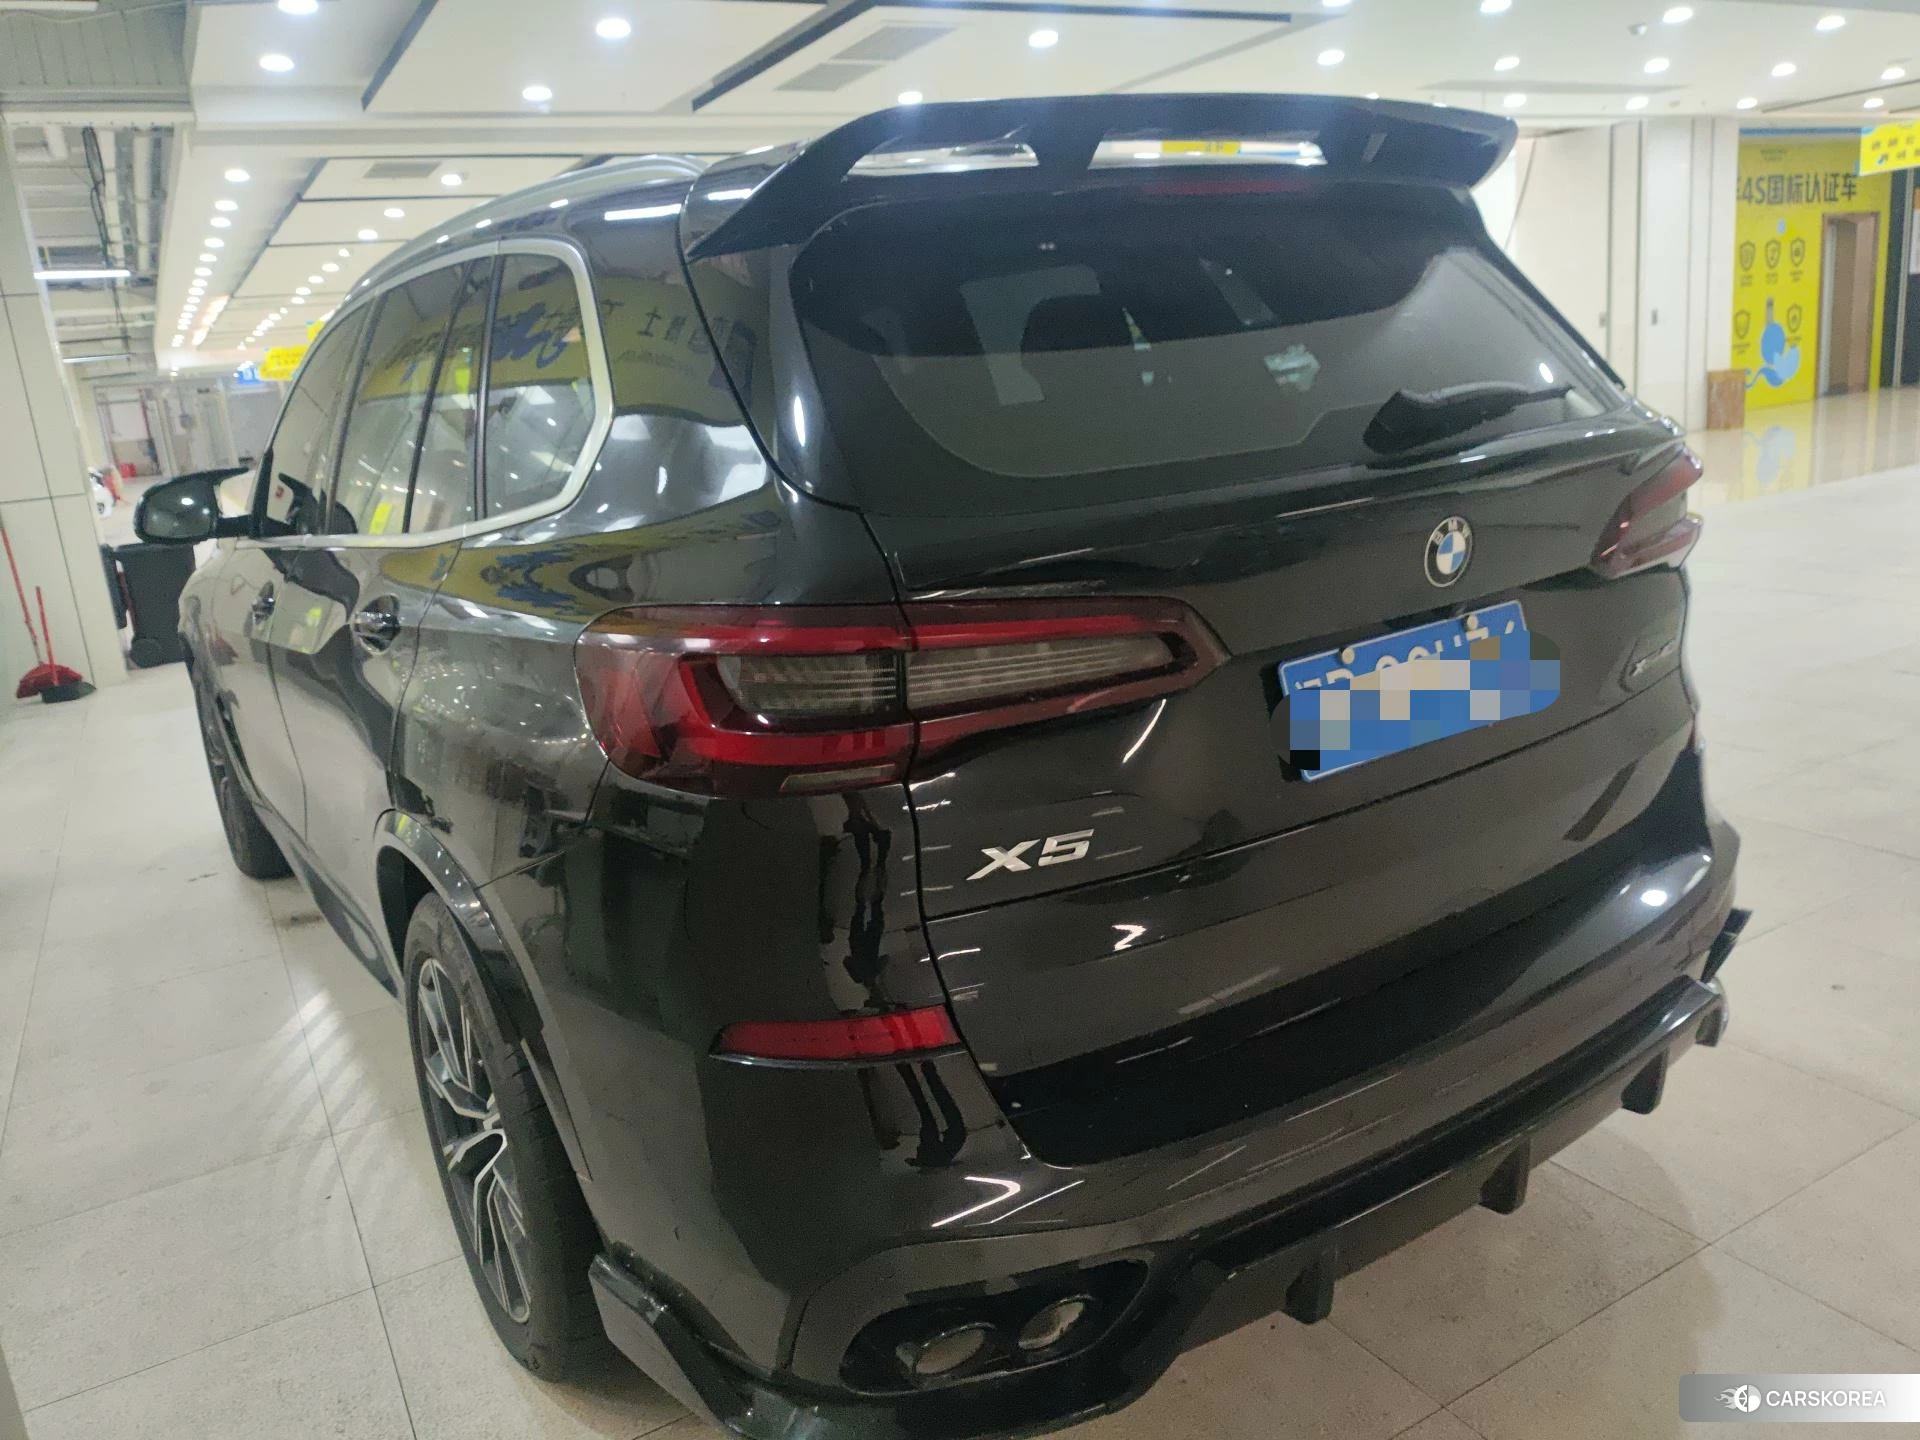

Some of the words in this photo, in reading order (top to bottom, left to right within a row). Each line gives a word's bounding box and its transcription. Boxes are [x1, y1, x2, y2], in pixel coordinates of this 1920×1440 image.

[1736, 172, 1858, 205] 4S国标认证车
[965, 828, 1095, 881] X5
